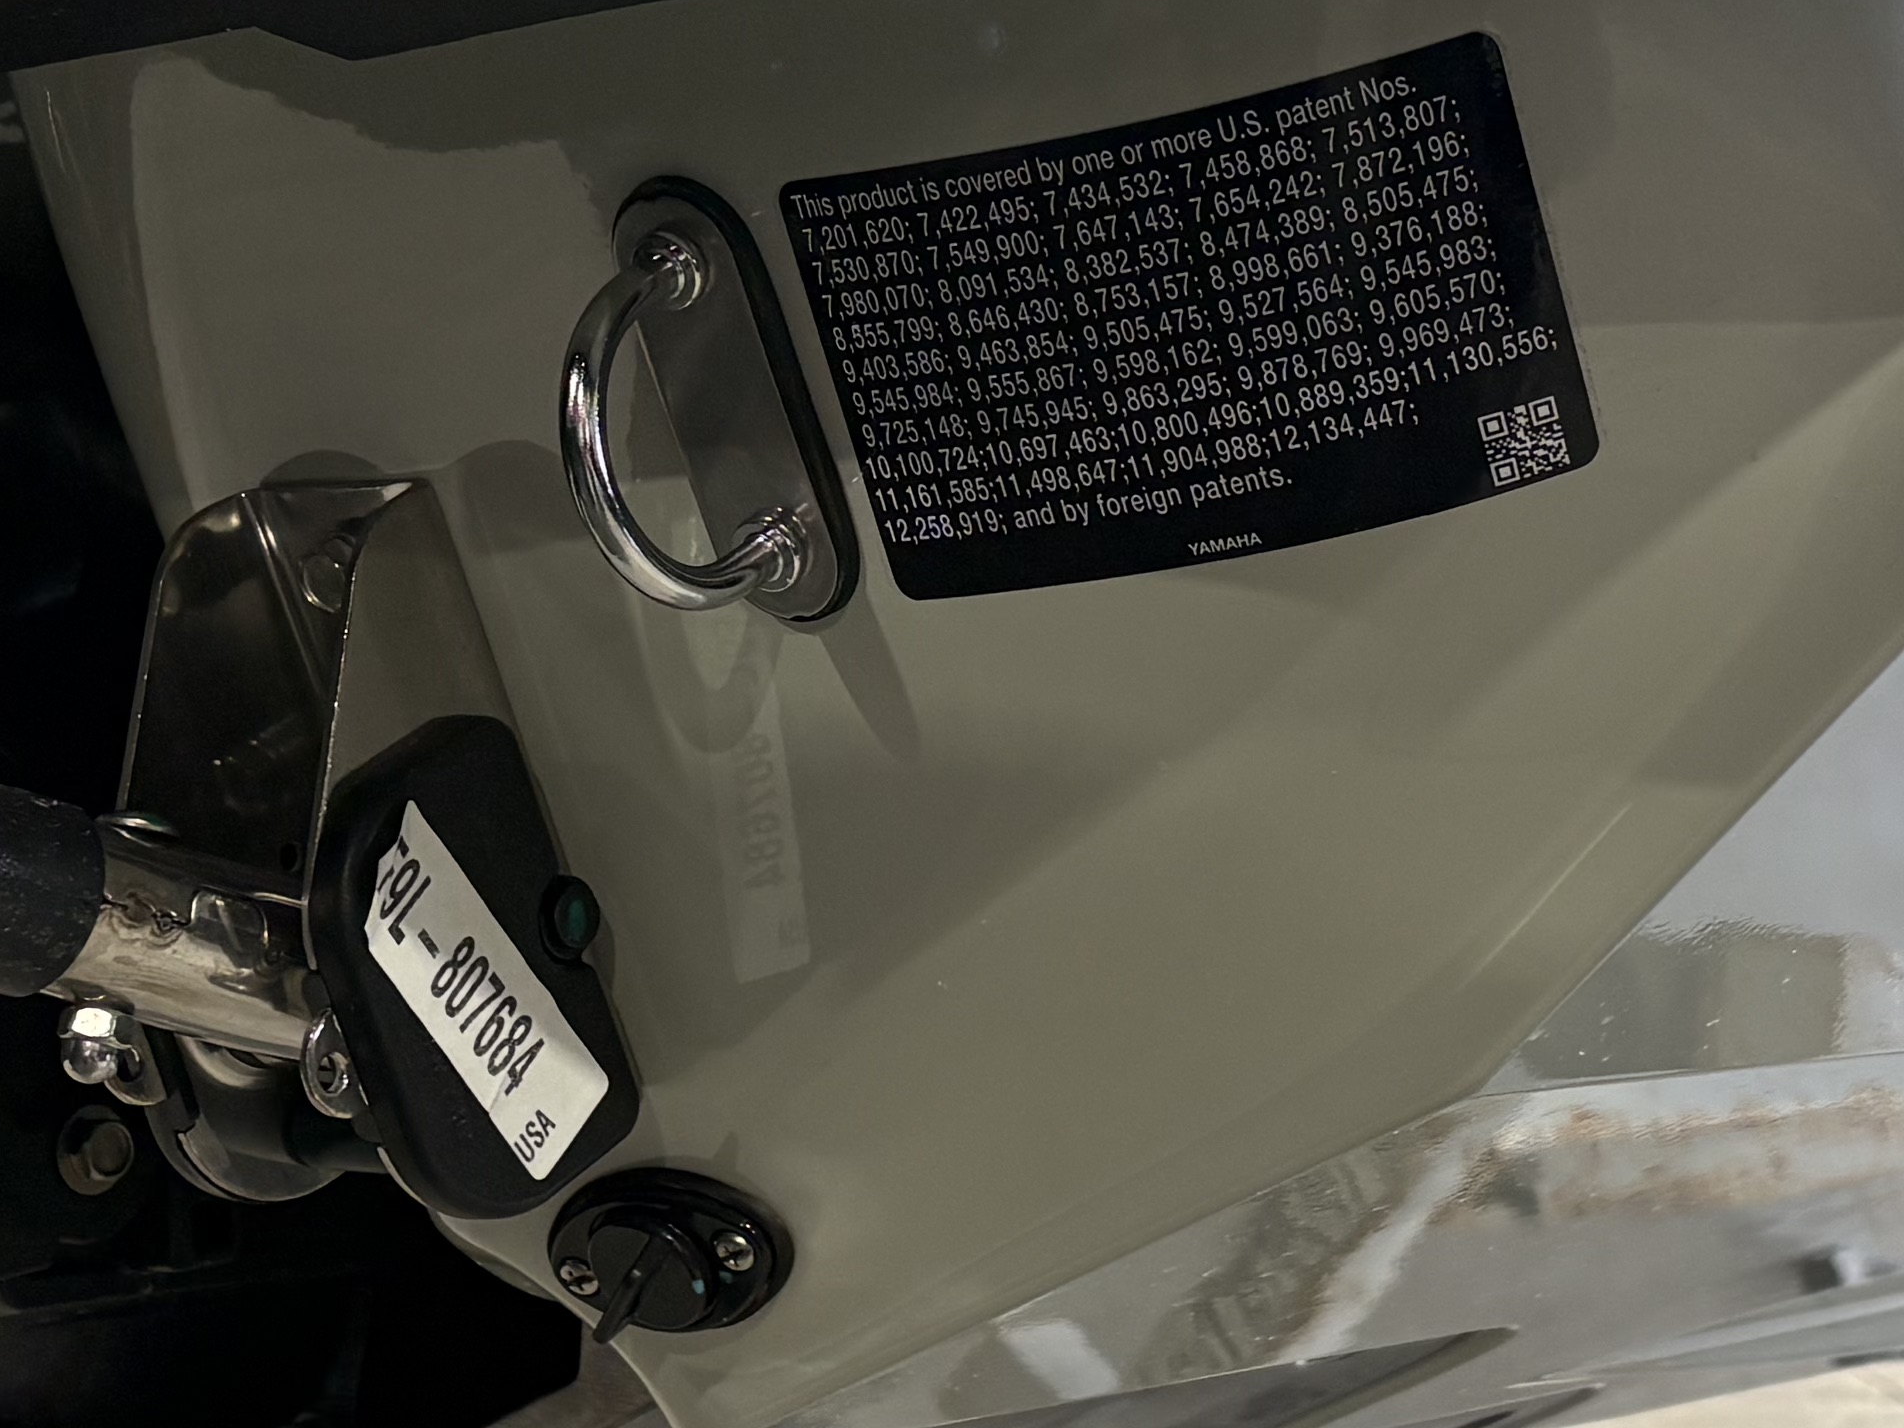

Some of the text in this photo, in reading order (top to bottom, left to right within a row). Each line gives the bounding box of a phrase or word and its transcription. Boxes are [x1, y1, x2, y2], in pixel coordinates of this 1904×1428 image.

[790, 76, 1416, 220] This product is covered by one or more U.S. patent Nos.
[802, 95, 1460, 255] 7,201,620; 7,422,495; 7,434,532; 7,458,868; 7,513,807;
[812, 131, 1469, 288] 7,530,870; 7,549,900; 7,647,143; 7,654,242; 7,872,196;
[821, 165, 1478, 321] 7,980,070; 8,091,534; 8,382,537; 8,474,389; 8,505,475;
[833, 201, 1487, 353] 8,555,799; 8,646,430; 8,753,157; 8,998,661; 9,376,188;
[842, 235, 1496, 386] 9,403,586; 9,463,854; 9,505,475; 9,527,564; 9,545,983;
[852, 269, 1505, 419] 9,545,984; 9,555,867; 9,598,162; 9,599,063; 9,605,570;
[862, 303, 1514, 450] 9,725,148; 9,745,945; 9,863,295; 9,878,769; 9,969,473;
[884, 466, 1292, 545] 12,258,919; and by foreign patents.
[1188, 532, 1262, 556] YAMAHA
[513, 1109, 556, 1163] USA
